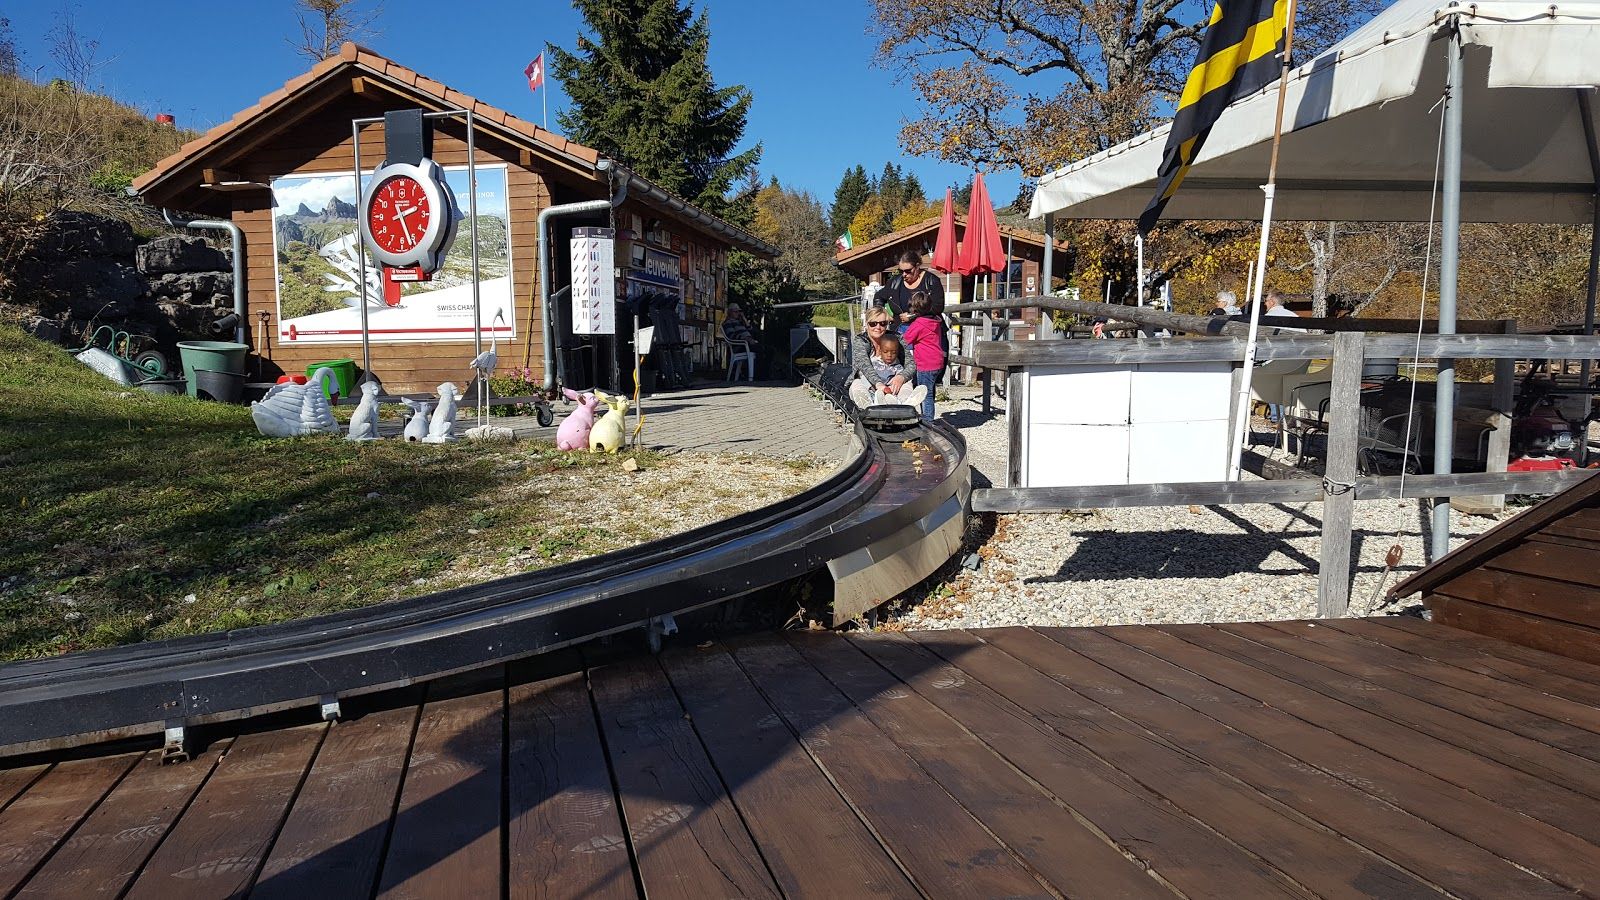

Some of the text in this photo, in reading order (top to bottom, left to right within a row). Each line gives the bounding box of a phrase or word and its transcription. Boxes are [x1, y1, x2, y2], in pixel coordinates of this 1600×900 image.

[455, 191, 495, 199] VICTINOX
[382, 201, 388, 209] 10
[418, 198, 423, 206] 2
[379, 213, 384, 221] 9
[421, 210, 426, 218] 3
[382, 225, 387, 234] 8
[400, 236, 405, 245] 6
[411, 233, 416, 241] 5
[437, 304, 456, 312] SWISS
